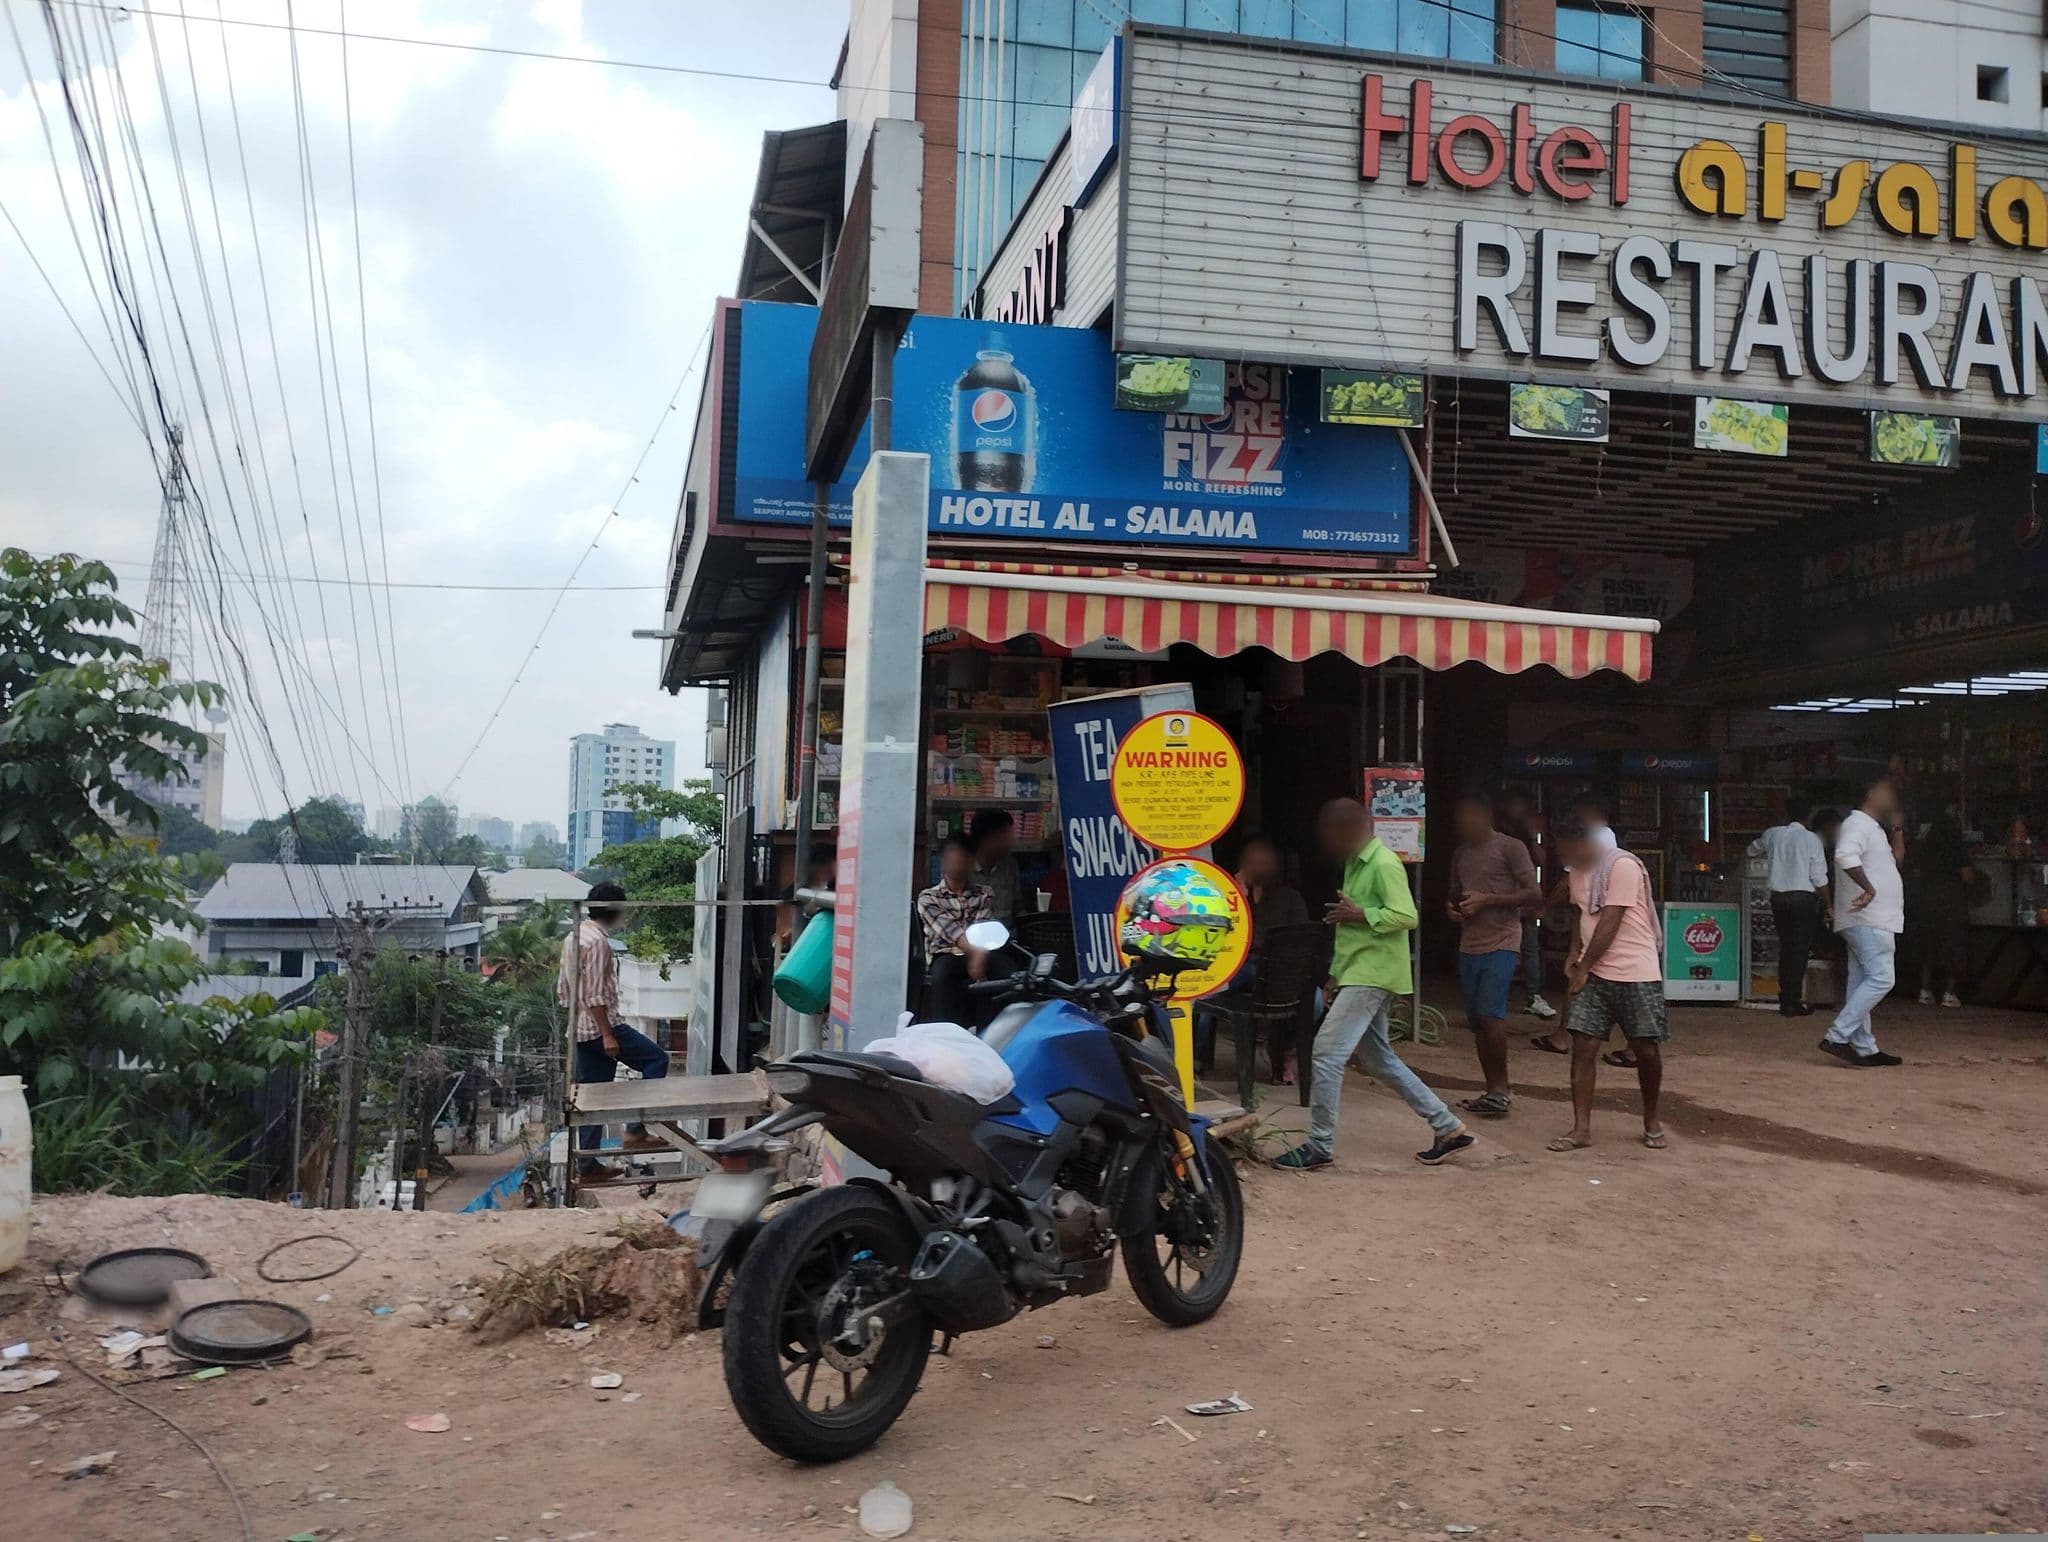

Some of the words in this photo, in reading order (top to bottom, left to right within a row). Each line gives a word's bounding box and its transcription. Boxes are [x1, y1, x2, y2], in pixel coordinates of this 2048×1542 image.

[1360, 73, 1631, 206] Hotel
[976, 437, 1012, 447] pepsi
[1163, 430, 1283, 484] FIZZ
[1163, 480, 1200, 492] MORE
[1204, 483, 1284, 497] REFRESHING
[939, 496, 1045, 529] HOTEL
[1053, 502, 1095, 531] AL
[1125, 506, 1257, 540] SALAMA
[1335, 531, 1400, 544] 7736573312
[1125, 751, 1228, 768] WARNING
[1541, 757, 1573, 767] pepsi
[1661, 759, 1692, 769] pepsi
[1085, 913, 1121, 974] JUI
